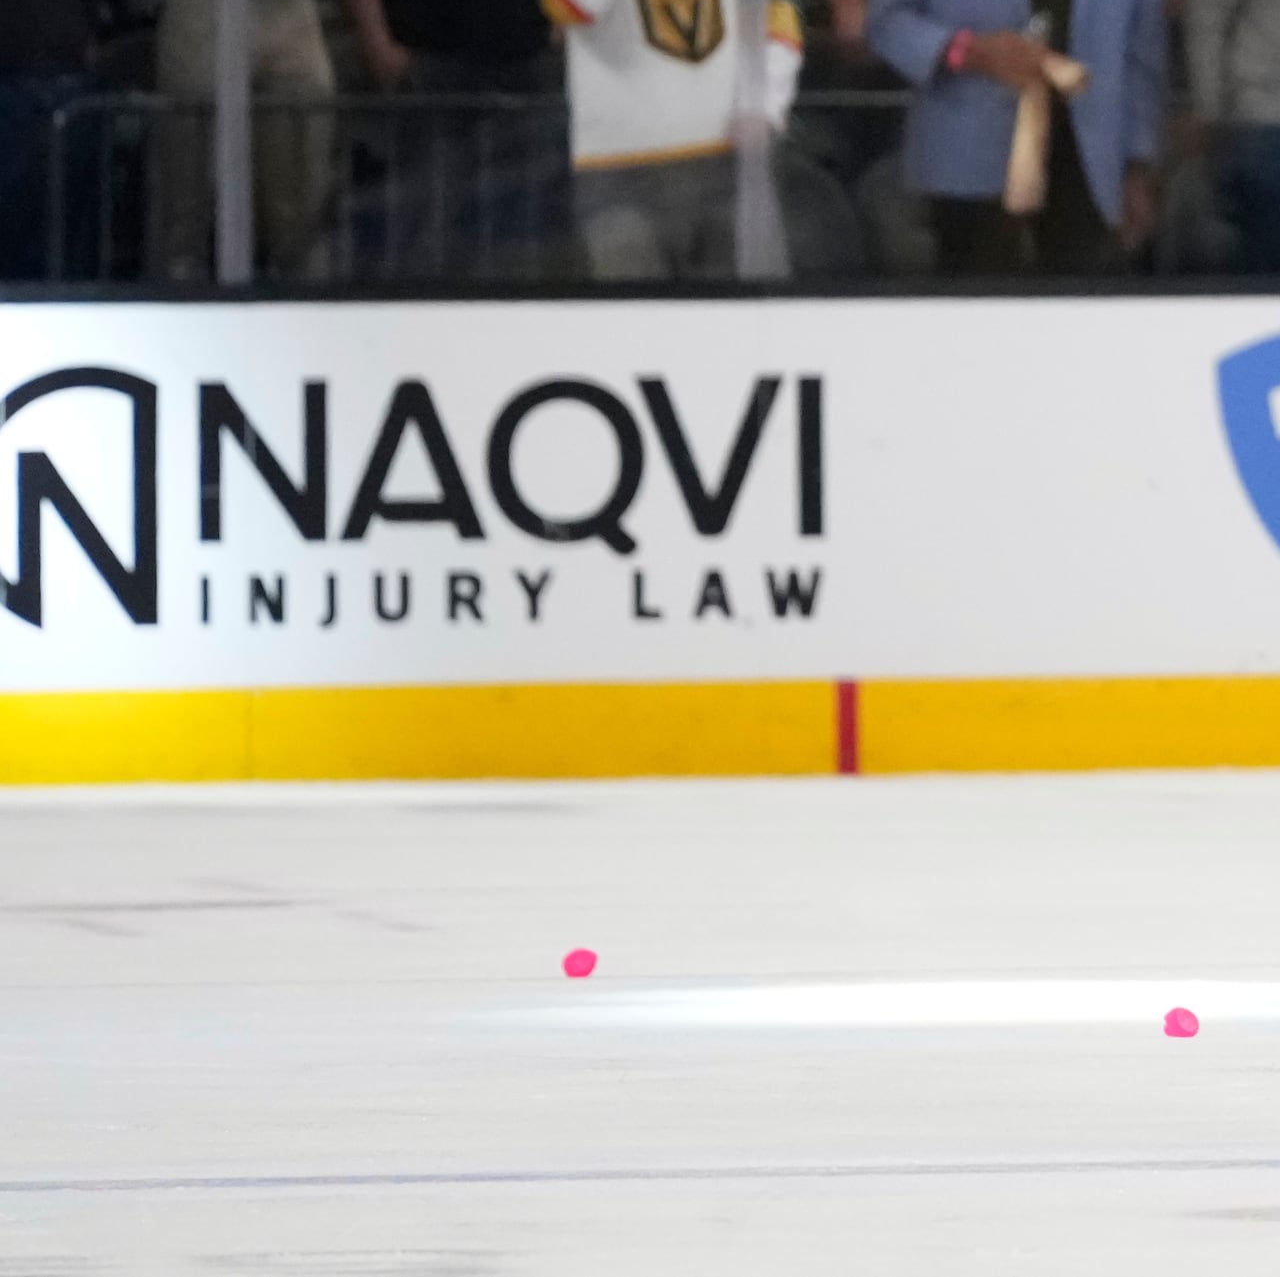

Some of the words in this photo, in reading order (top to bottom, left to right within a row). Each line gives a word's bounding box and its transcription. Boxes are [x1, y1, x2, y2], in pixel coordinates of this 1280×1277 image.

[199, 375, 824, 555] NAQVI
[202, 571, 549, 626] INJURY
[634, 569, 822, 620] LAW
